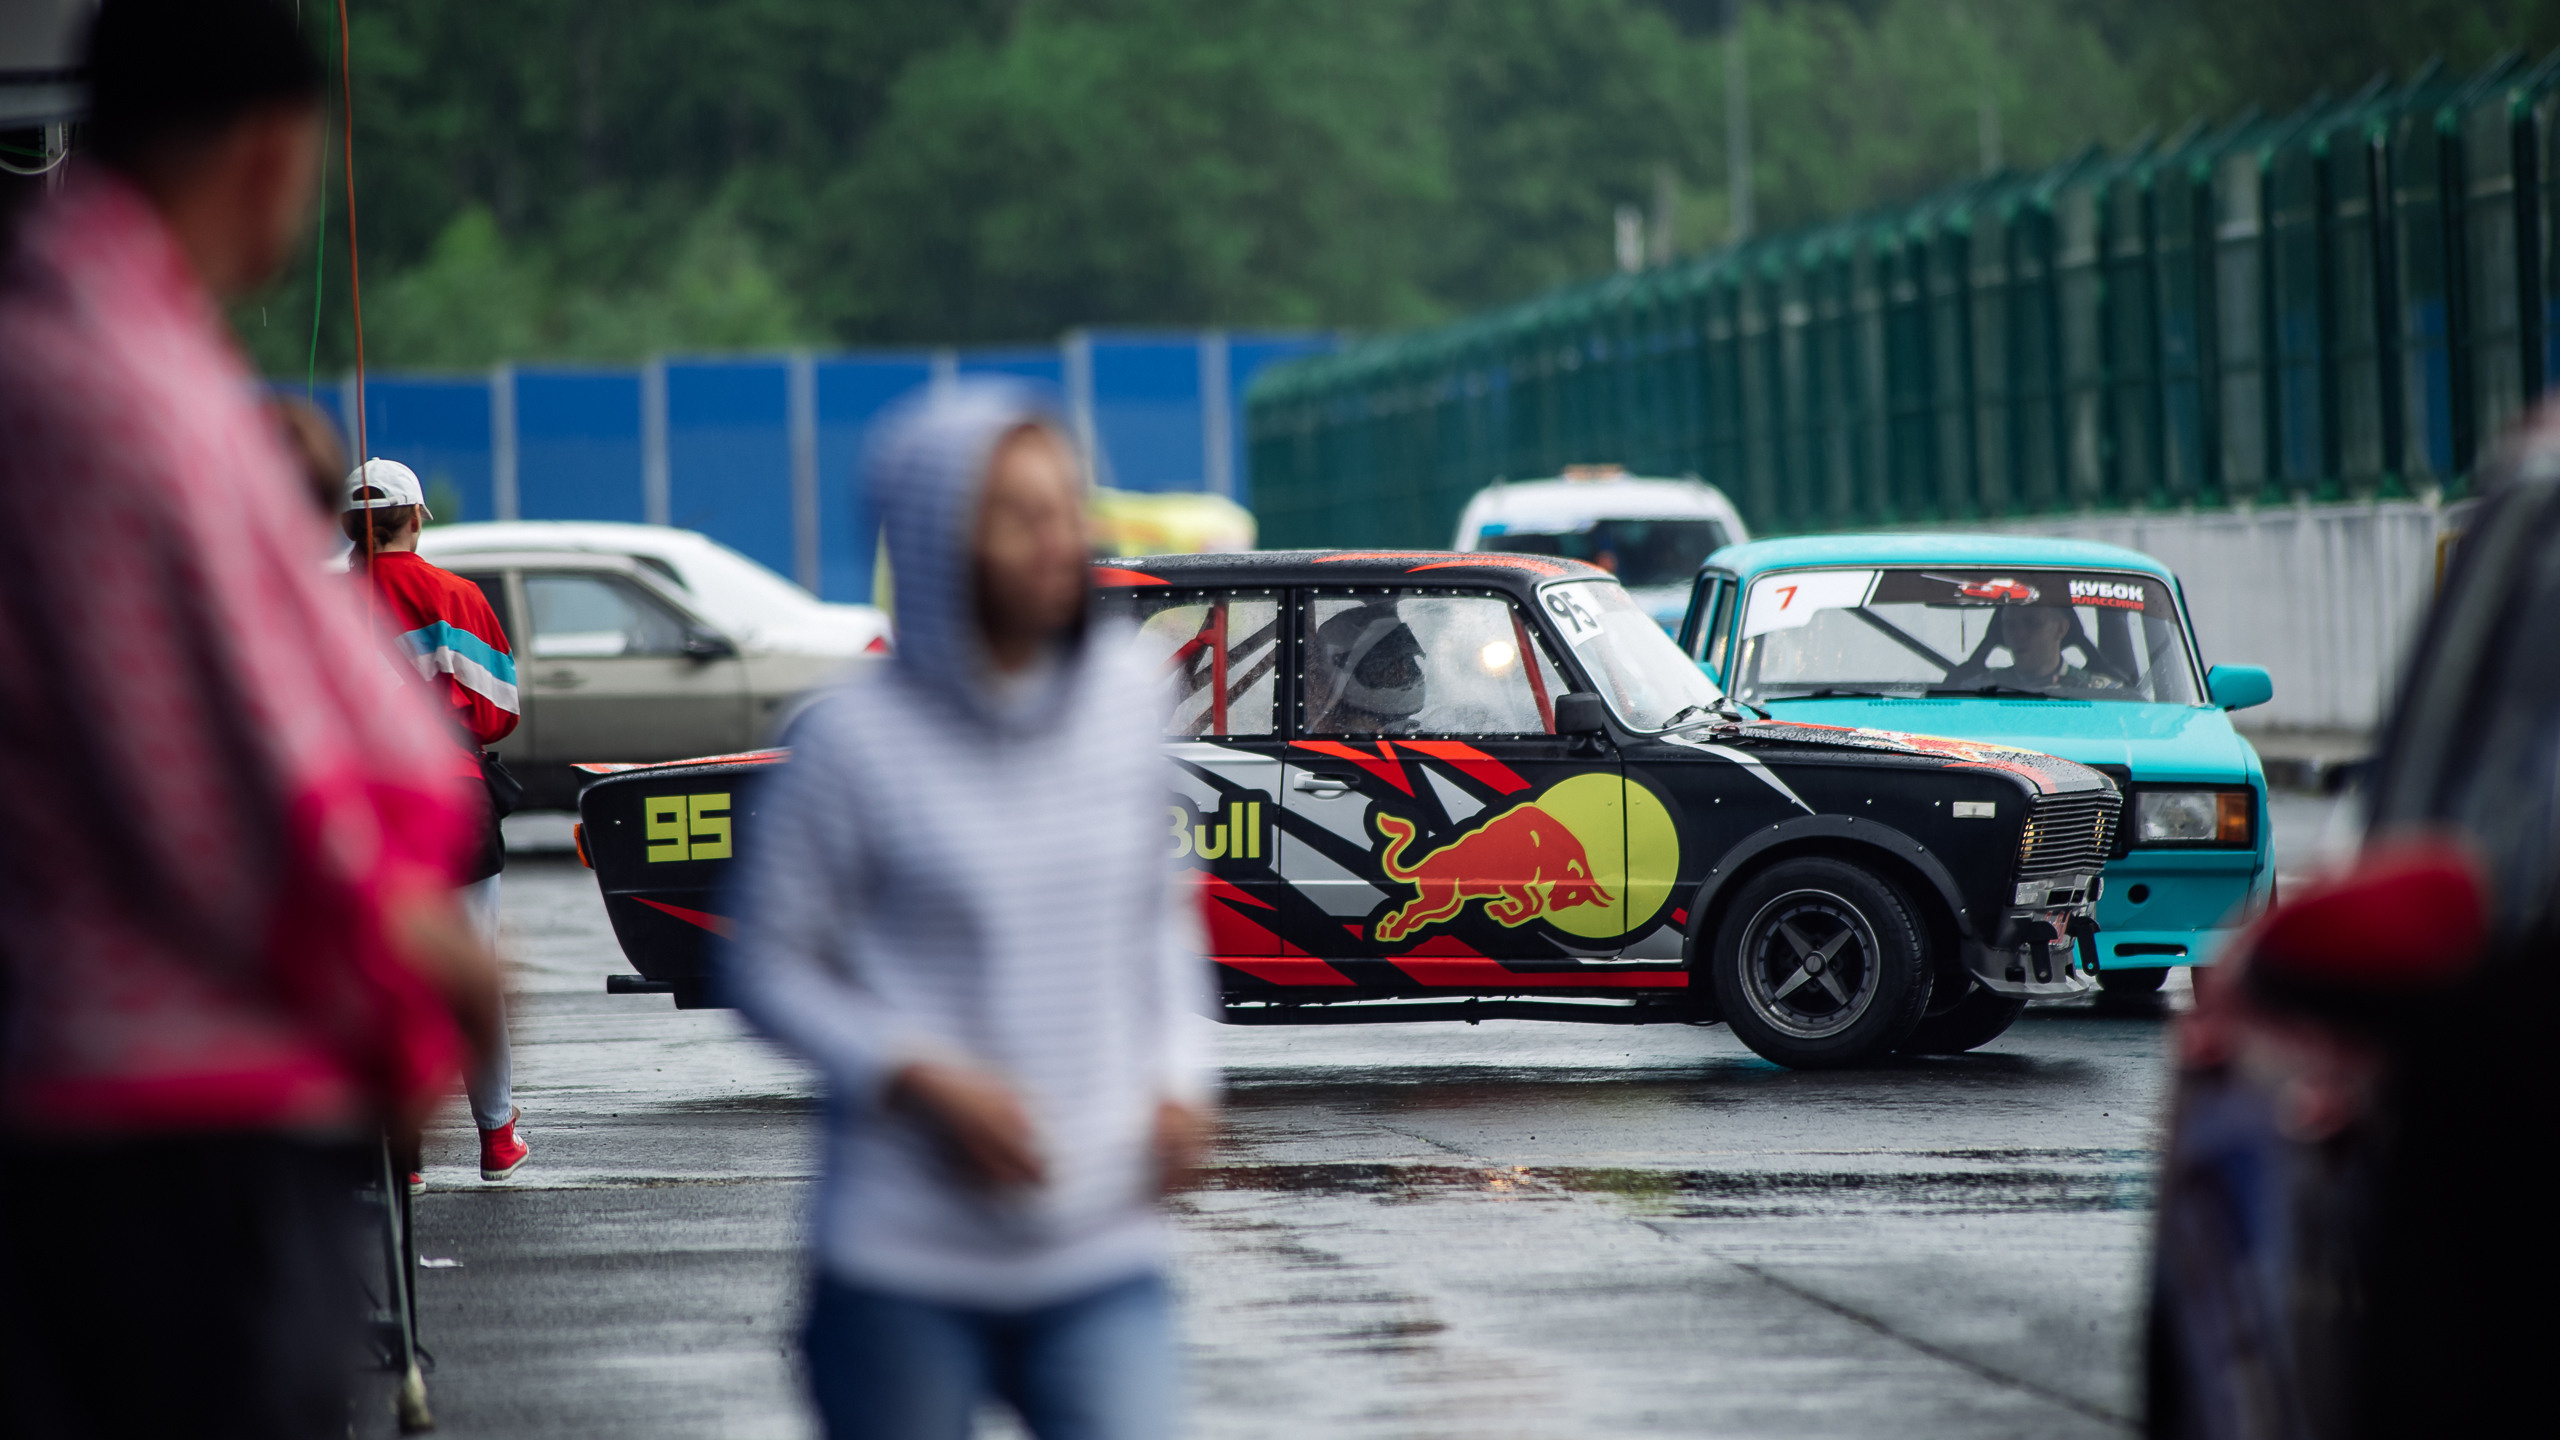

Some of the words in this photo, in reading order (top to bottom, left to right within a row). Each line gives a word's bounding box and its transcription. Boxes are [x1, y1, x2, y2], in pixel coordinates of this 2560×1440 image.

[1776, 585, 1798, 610] 7
[2069, 580, 2144, 602] КУБОК
[2071, 596, 2144, 611] КЛАССИКИ
[1546, 592, 1598, 634] 95
[645, 793, 733, 863] 95
